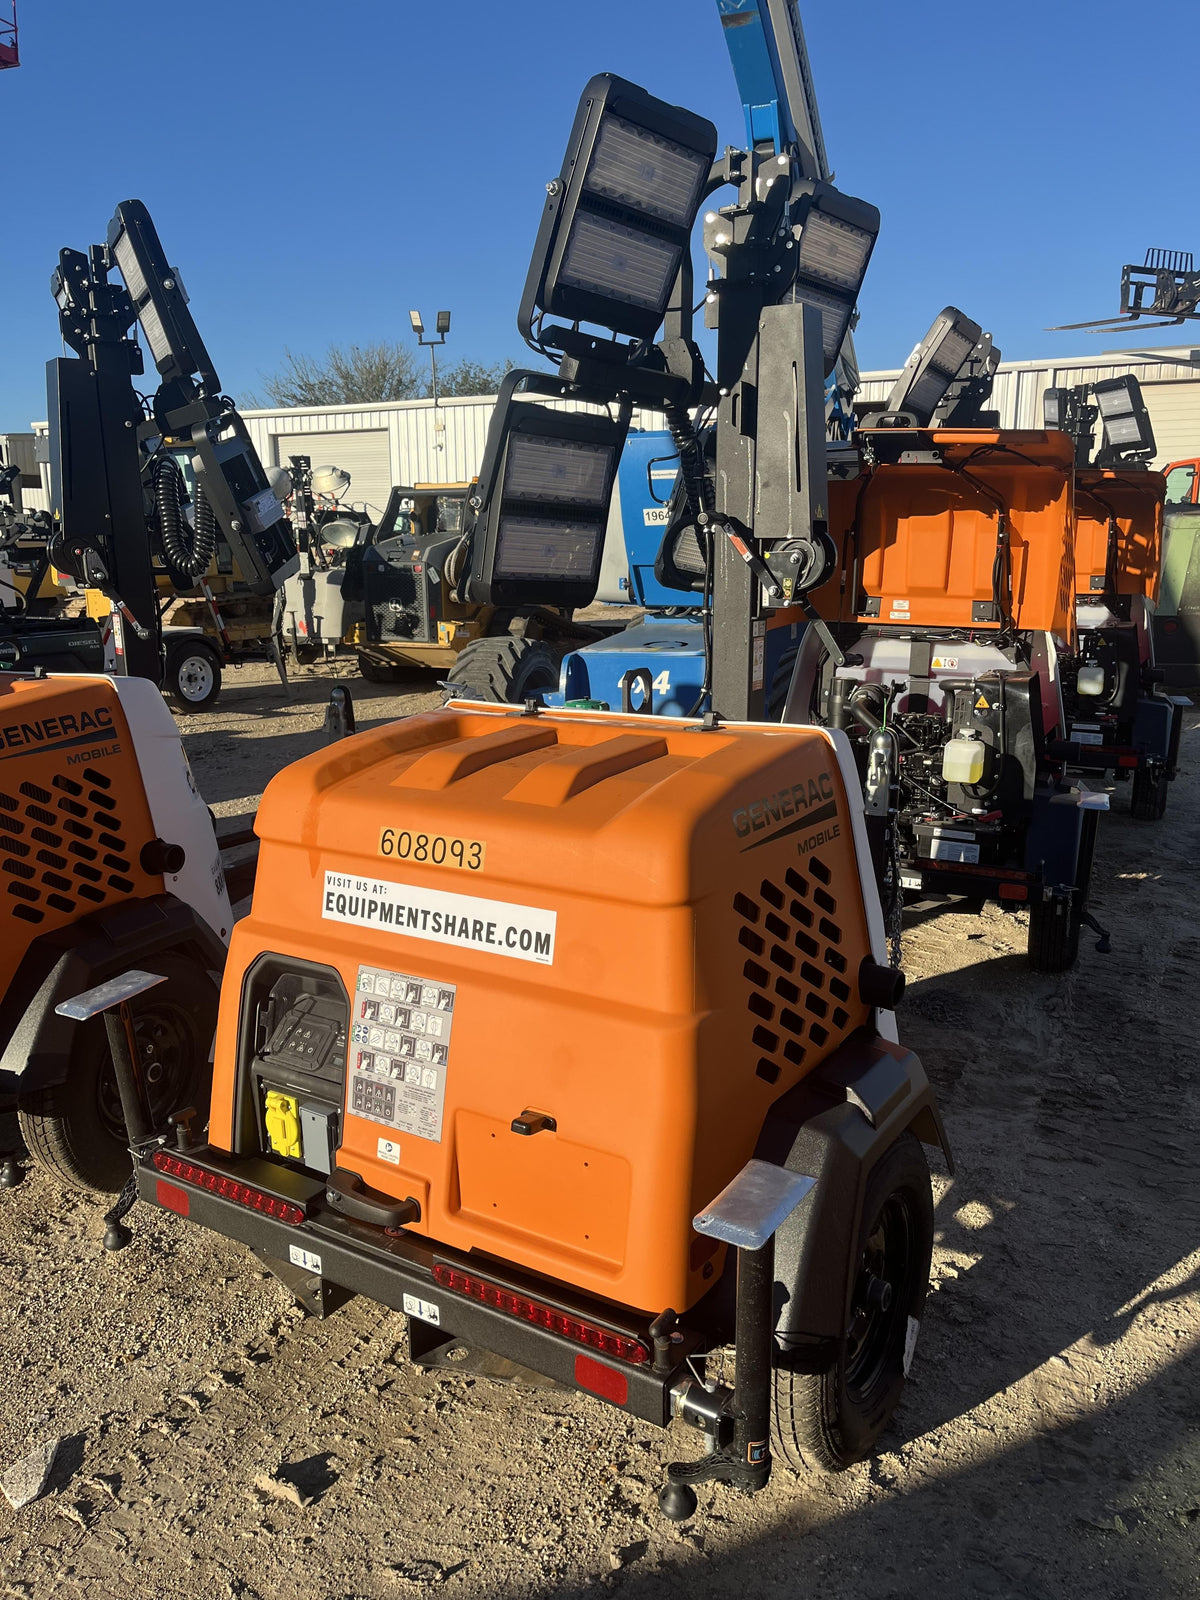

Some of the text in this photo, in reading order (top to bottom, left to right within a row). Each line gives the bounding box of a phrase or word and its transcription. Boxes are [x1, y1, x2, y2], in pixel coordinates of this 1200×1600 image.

[0, 707, 113, 749] ENERAC
[66, 744, 122, 766] MOBILE
[731, 772, 834, 838] GENERAC
[380, 828, 483, 870] 608093
[797, 824, 841, 856] MOBILE
[326, 875, 388, 895] VISIT US AT:
[325, 891, 552, 956] EQUIPMENTSHARE.COM
